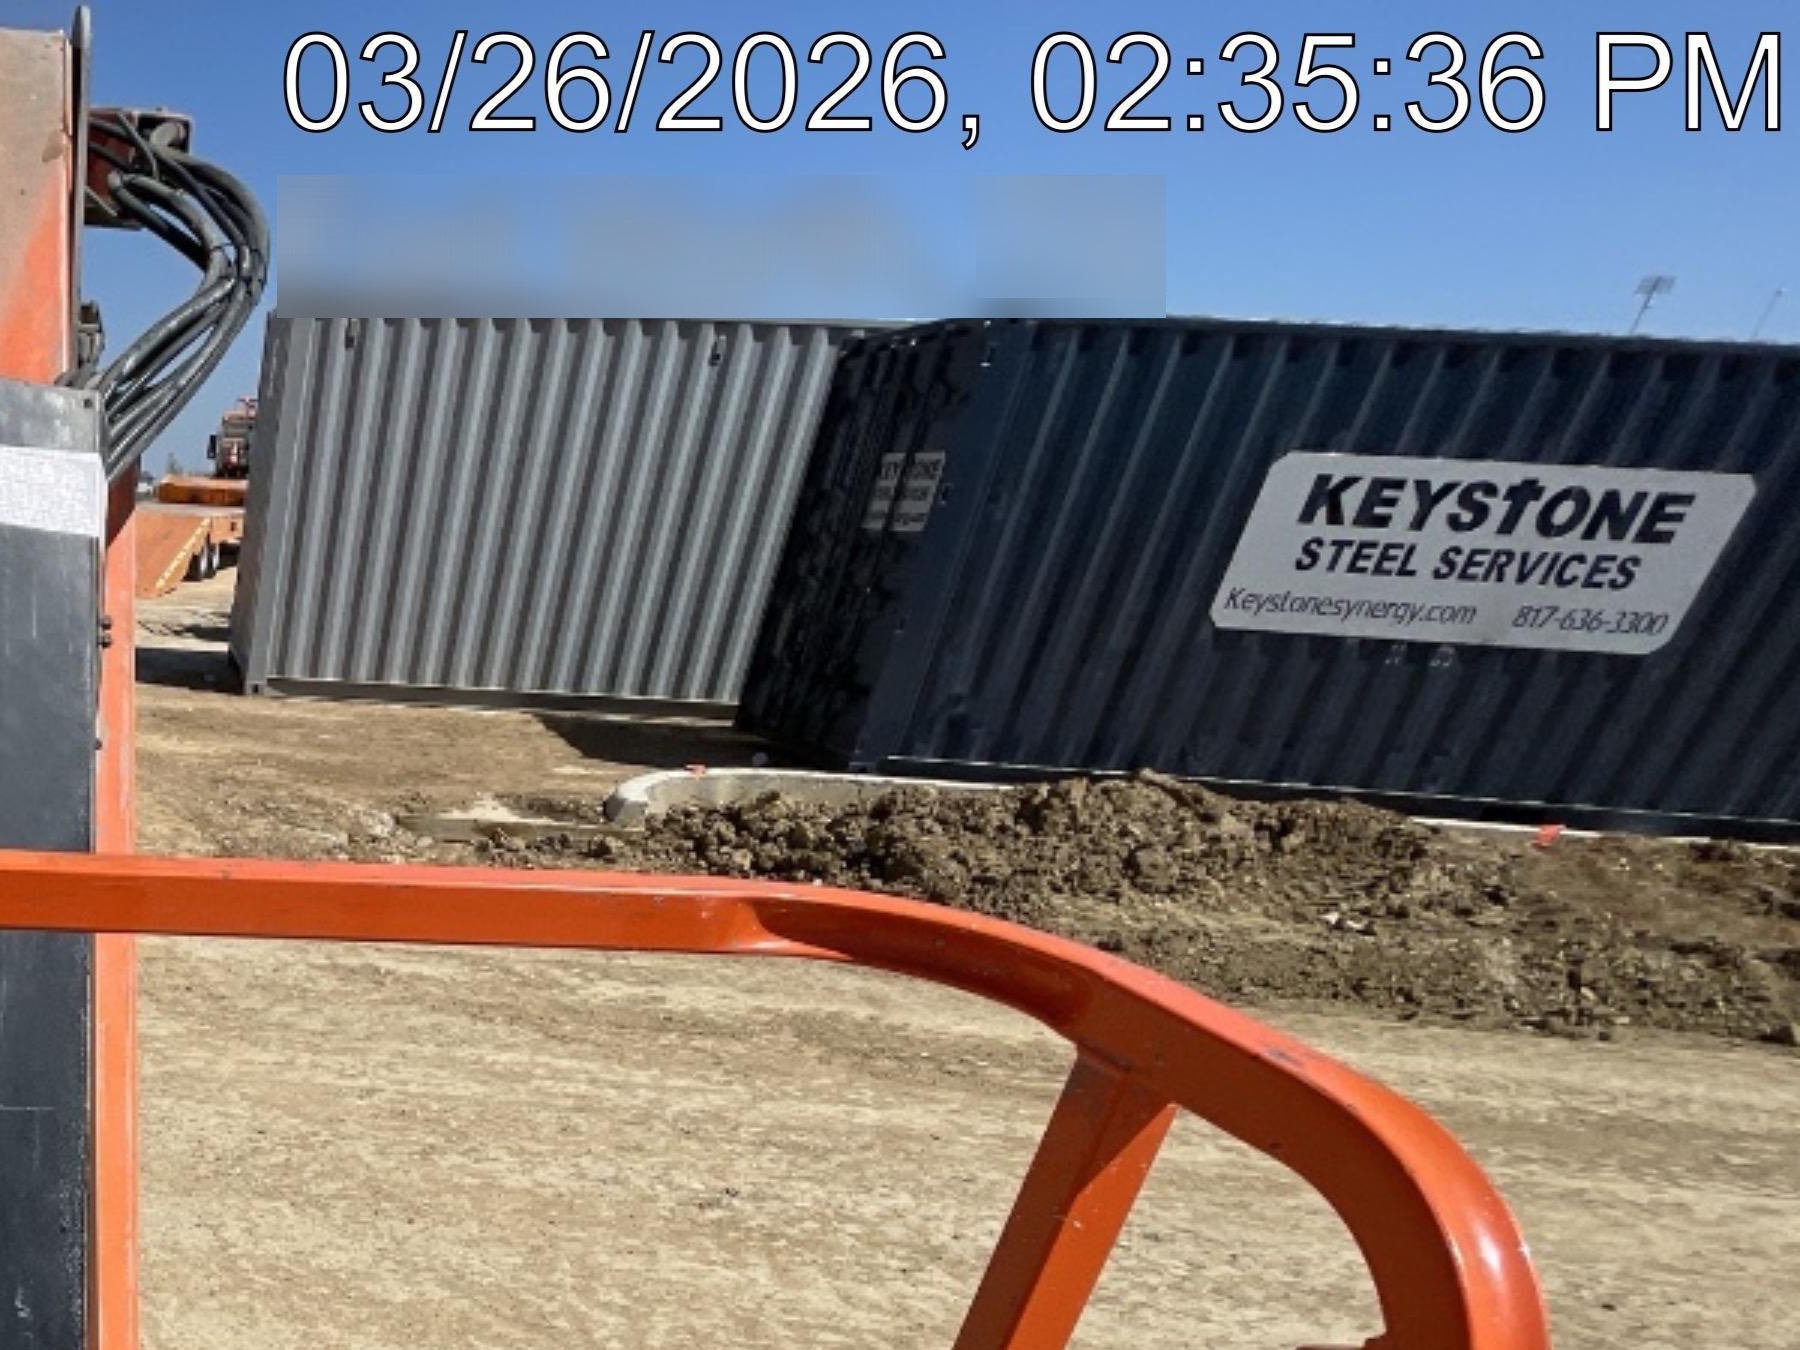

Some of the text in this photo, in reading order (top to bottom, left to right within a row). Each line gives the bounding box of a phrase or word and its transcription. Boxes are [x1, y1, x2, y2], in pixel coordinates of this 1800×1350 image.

[1297, 473, 1696, 545] KEYSTONE
[1295, 537, 1642, 592] STEEL SERVICES
[1223, 587, 1669, 637] Keystonesynergy.com 817-636-3300
